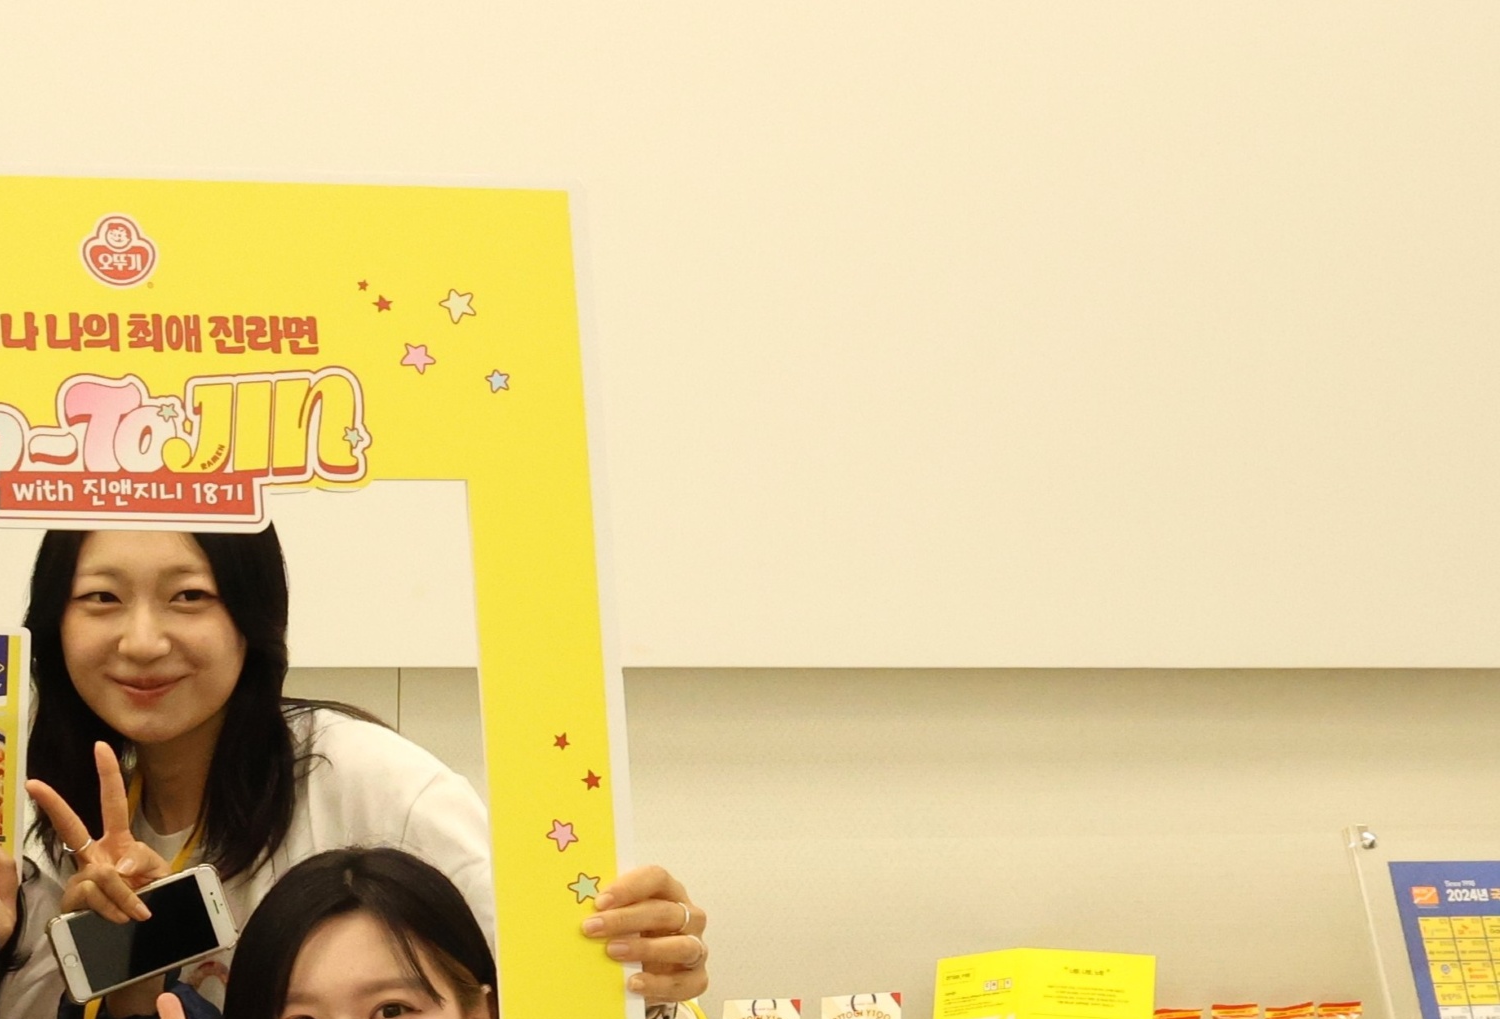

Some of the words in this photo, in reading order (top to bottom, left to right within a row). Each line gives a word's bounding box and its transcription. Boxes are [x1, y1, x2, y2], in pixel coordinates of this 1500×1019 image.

[98, 253, 142, 272] 오뚜기
[45, 311, 119, 352] 나의
[127, 313, 202, 353] 최애
[208, 315, 319, 355] 진라면
[200, 444, 226, 471] RAMEN
[12, 479, 74, 502] with
[82, 478, 183, 507] 진앤지니
[192, 479, 244, 505] 18기
[1446, 888, 1489, 902] 2024년
